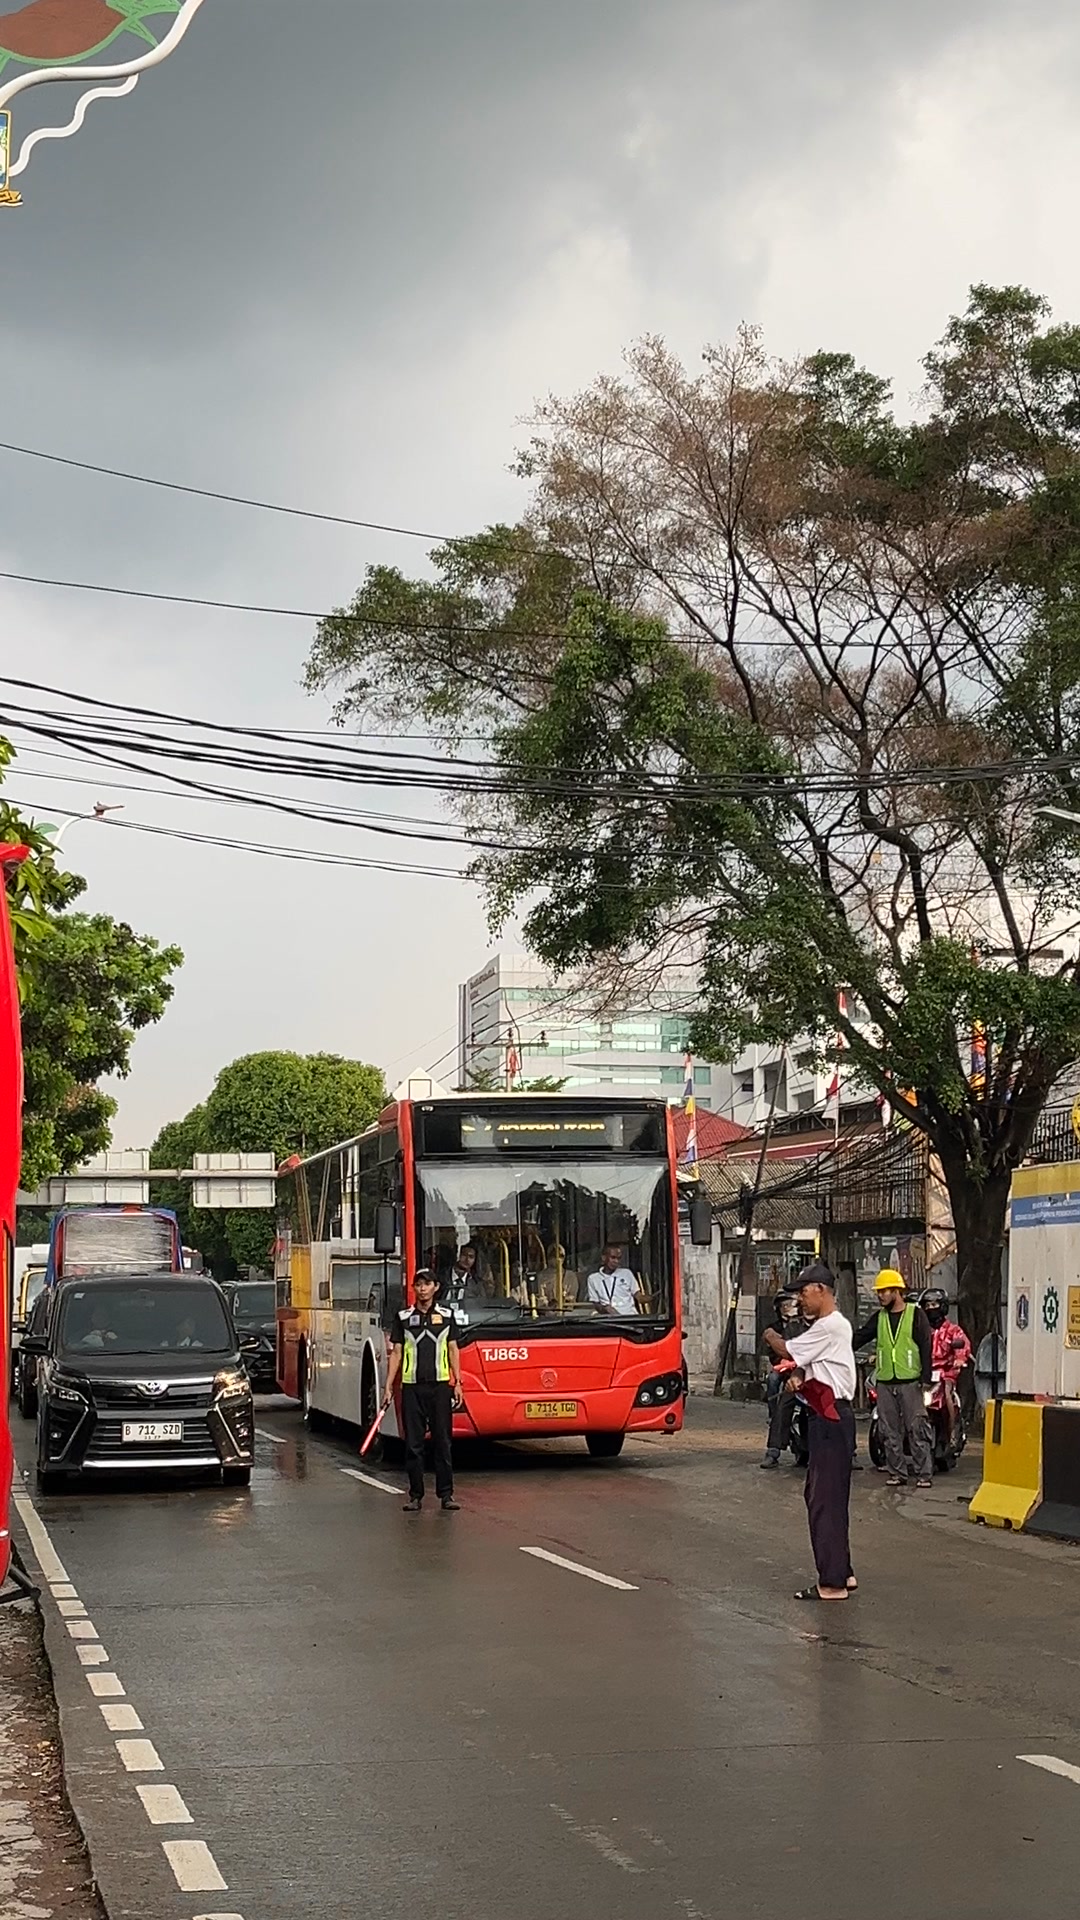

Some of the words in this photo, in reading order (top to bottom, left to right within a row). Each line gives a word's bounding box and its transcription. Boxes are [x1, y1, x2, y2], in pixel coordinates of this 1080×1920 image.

[482, 1348, 528, 1361] TJ863
[527, 1403, 533, 1413] B
[125, 1425, 131, 1435] B
[138, 1425, 156, 1435] 712
[162, 1424, 180, 1435] SZD
